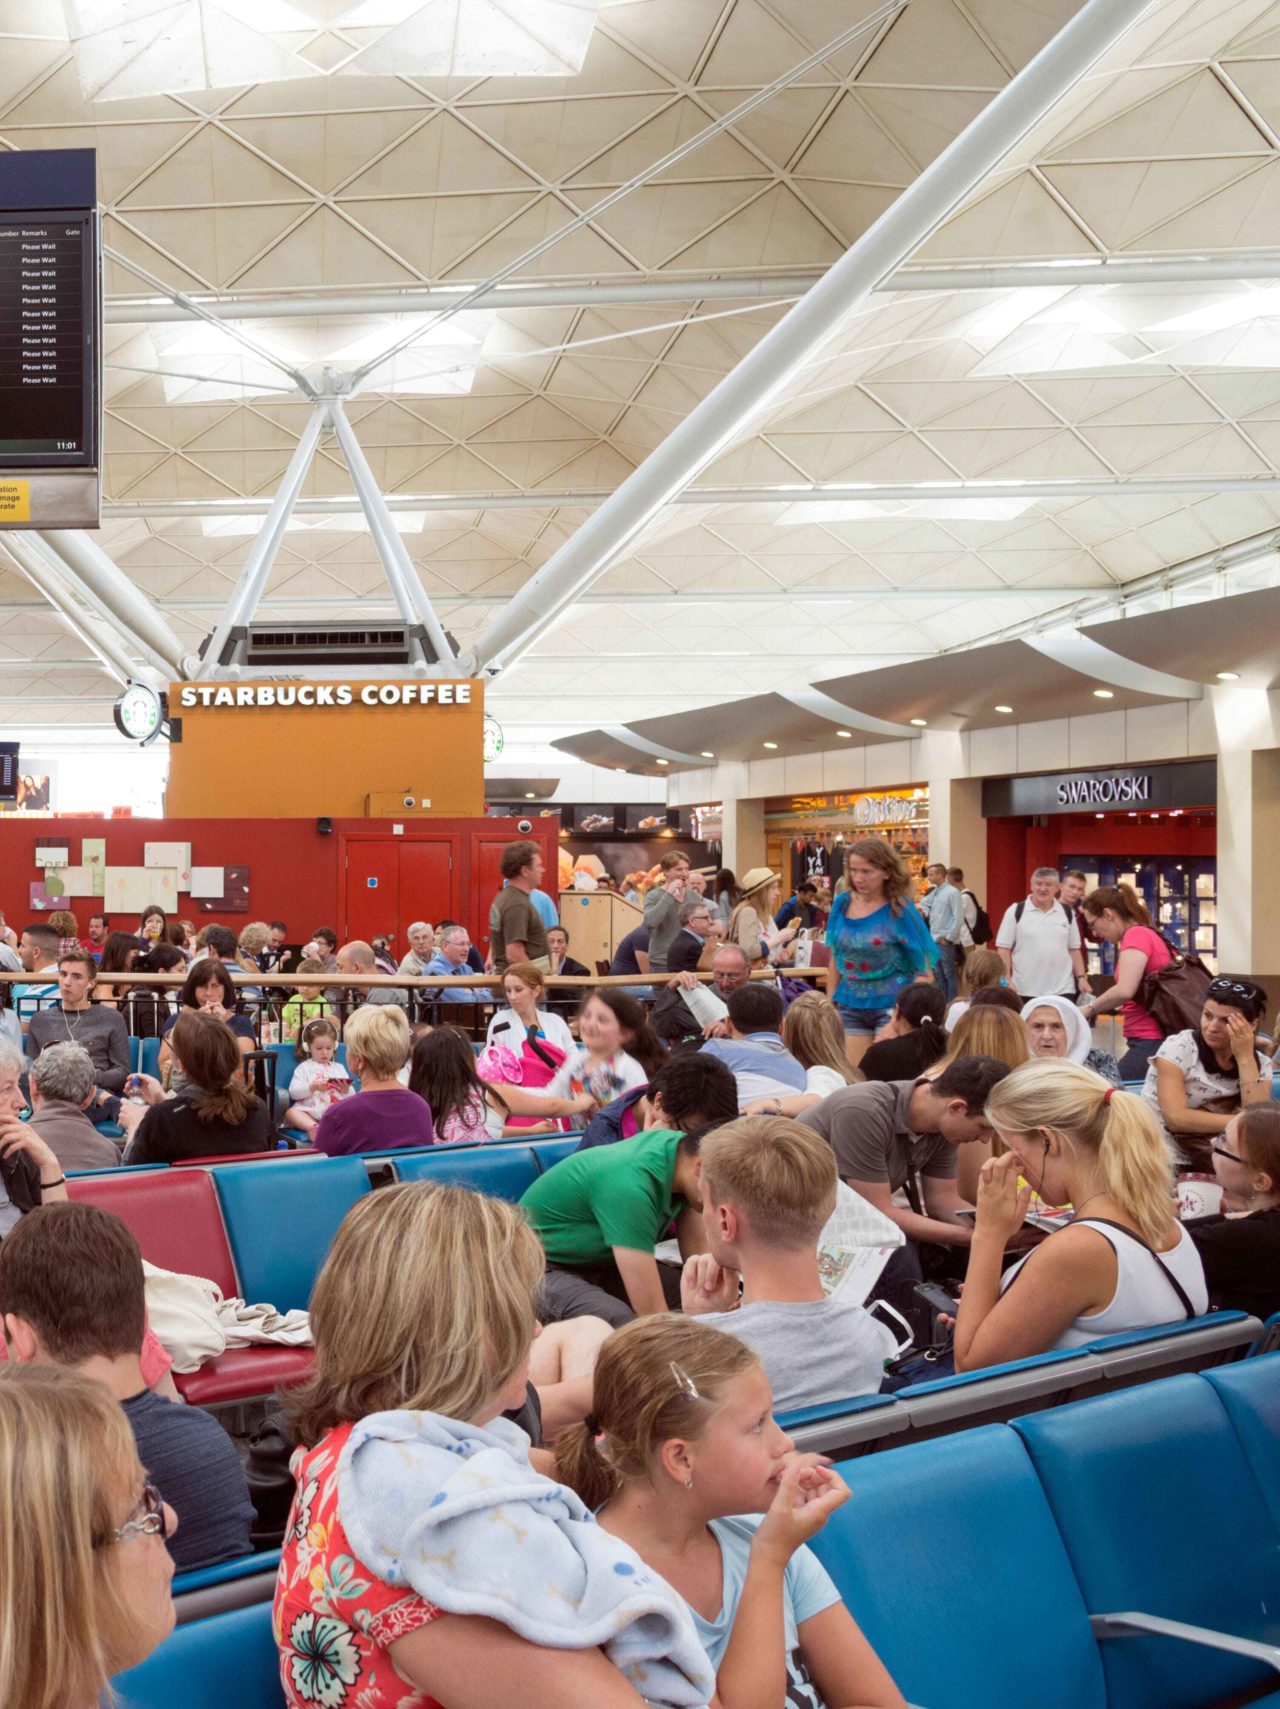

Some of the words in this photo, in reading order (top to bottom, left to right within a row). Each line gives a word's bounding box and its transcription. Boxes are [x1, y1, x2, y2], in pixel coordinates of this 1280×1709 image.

[180, 685, 352, 707] STARBUCKS
[360, 684, 472, 705] COFFEE
[1057, 775, 1151, 805] SWAROVSKI
